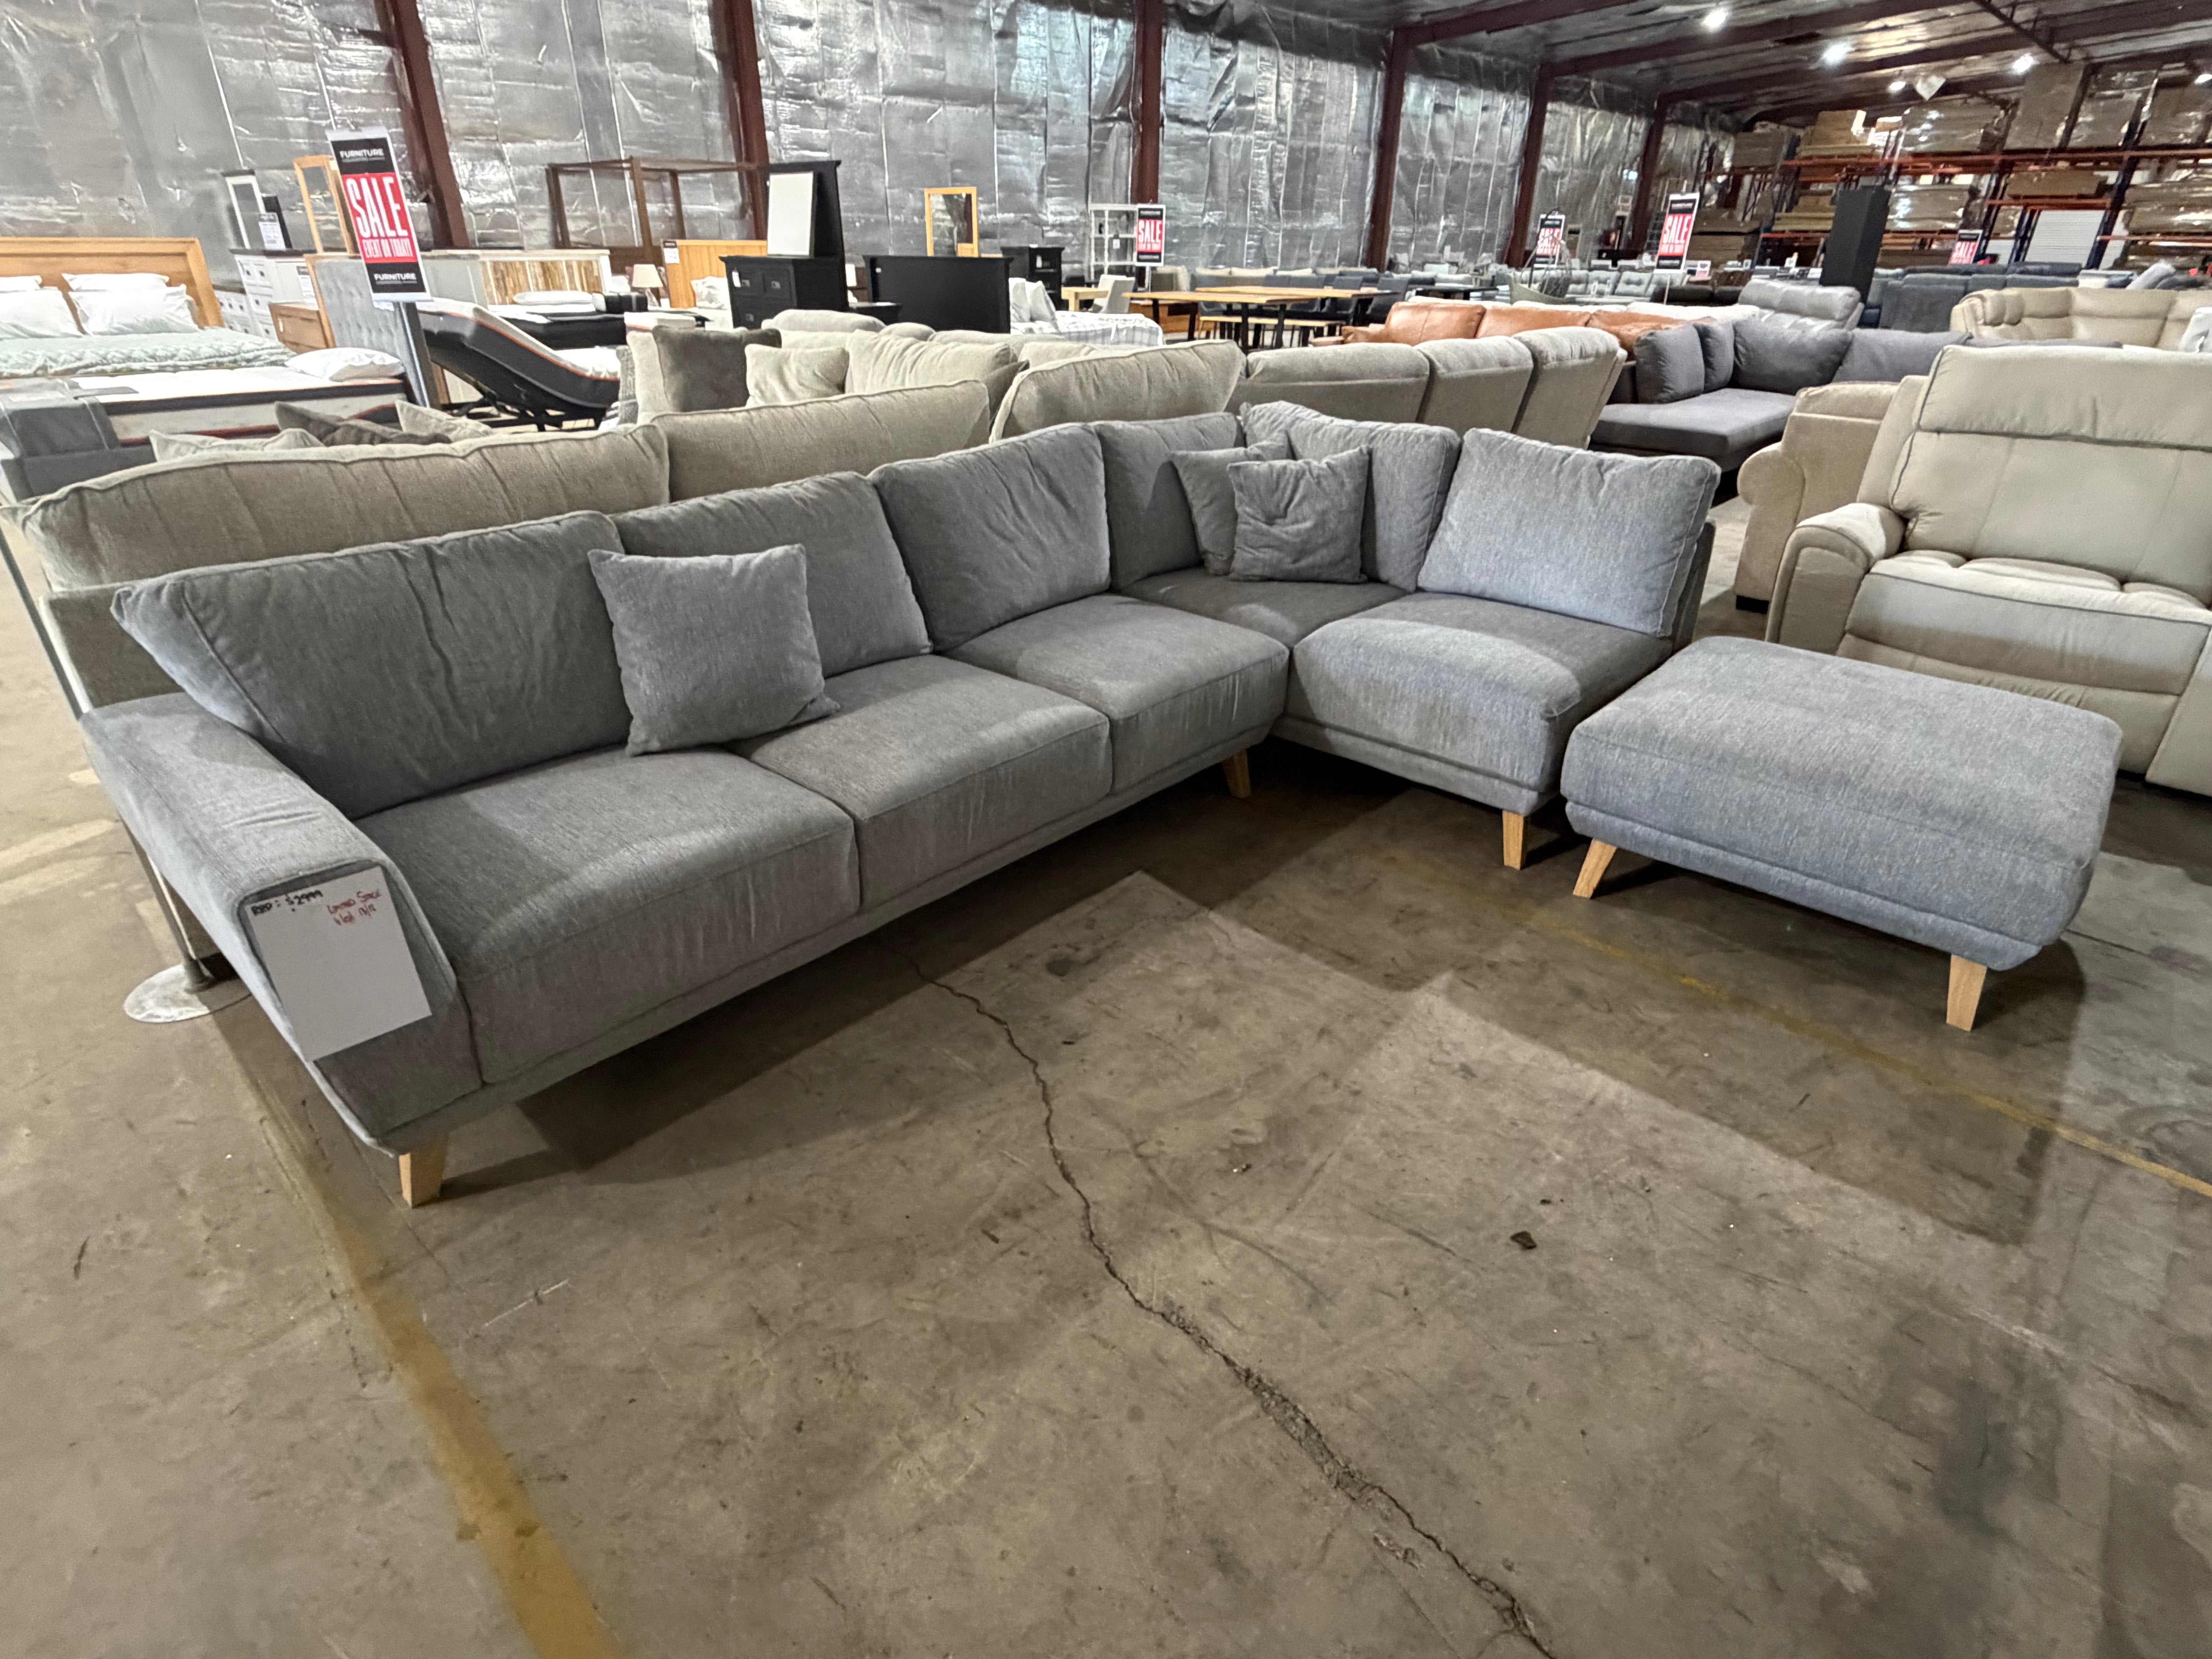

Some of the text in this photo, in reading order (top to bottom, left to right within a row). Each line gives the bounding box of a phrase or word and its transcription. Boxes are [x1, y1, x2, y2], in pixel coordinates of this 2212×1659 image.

[340, 148, 384, 158] FURNITURE
[346, 176, 409, 238] SALE
[1138, 220, 1162, 242] SALE
[1662, 215, 1692, 244] SALE
